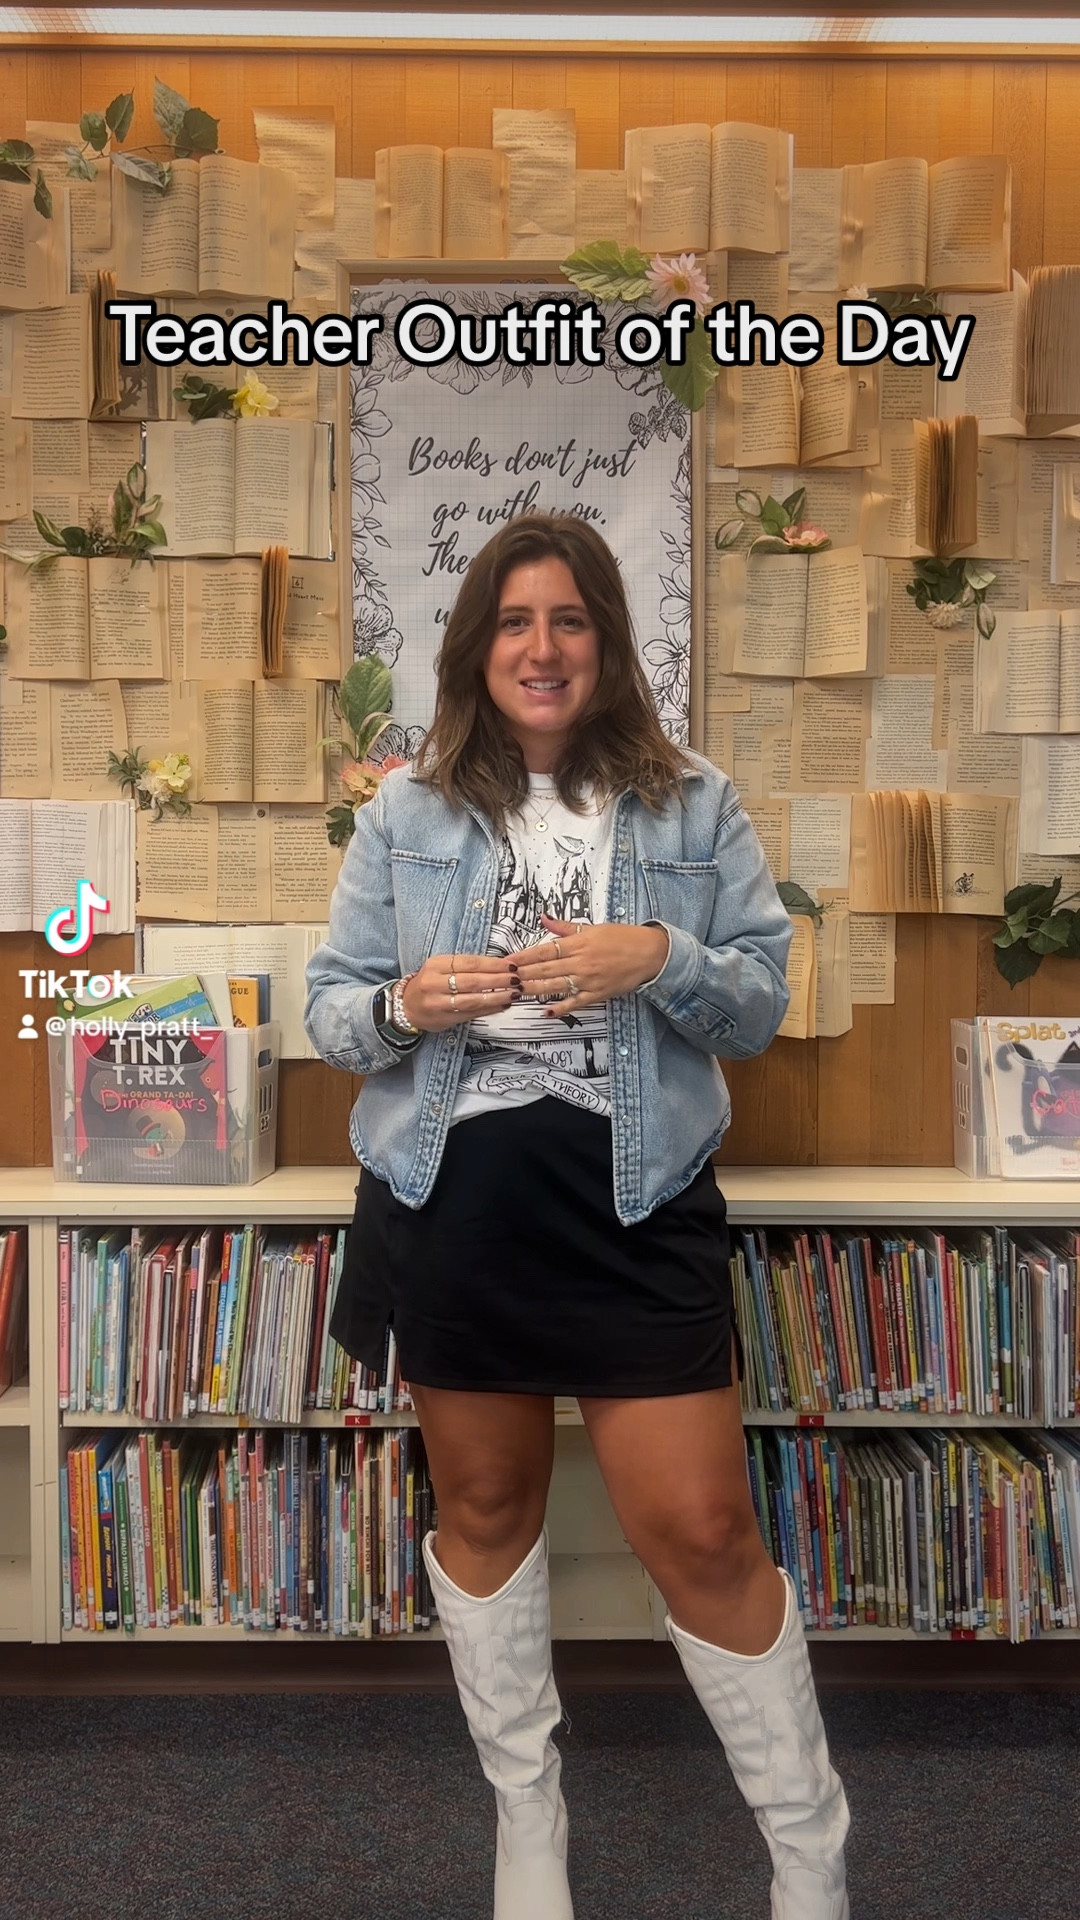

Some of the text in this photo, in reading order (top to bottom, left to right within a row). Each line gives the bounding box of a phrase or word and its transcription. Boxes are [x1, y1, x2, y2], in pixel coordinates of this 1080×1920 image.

[407, 437, 638, 488] Books don't just
[431, 502, 469, 538] go
[477, 481, 541, 525] with
[422, 531, 475, 576] The
[997, 1022, 1066, 1043] Splat
[110, 1039, 187, 1064] TINY
[113, 1066, 185, 1085] T. REX
[553, 1080, 596, 1106] THEORY
[354, 1416, 360, 1424] K
[120, 1529, 128, 1556] BUFFALO
